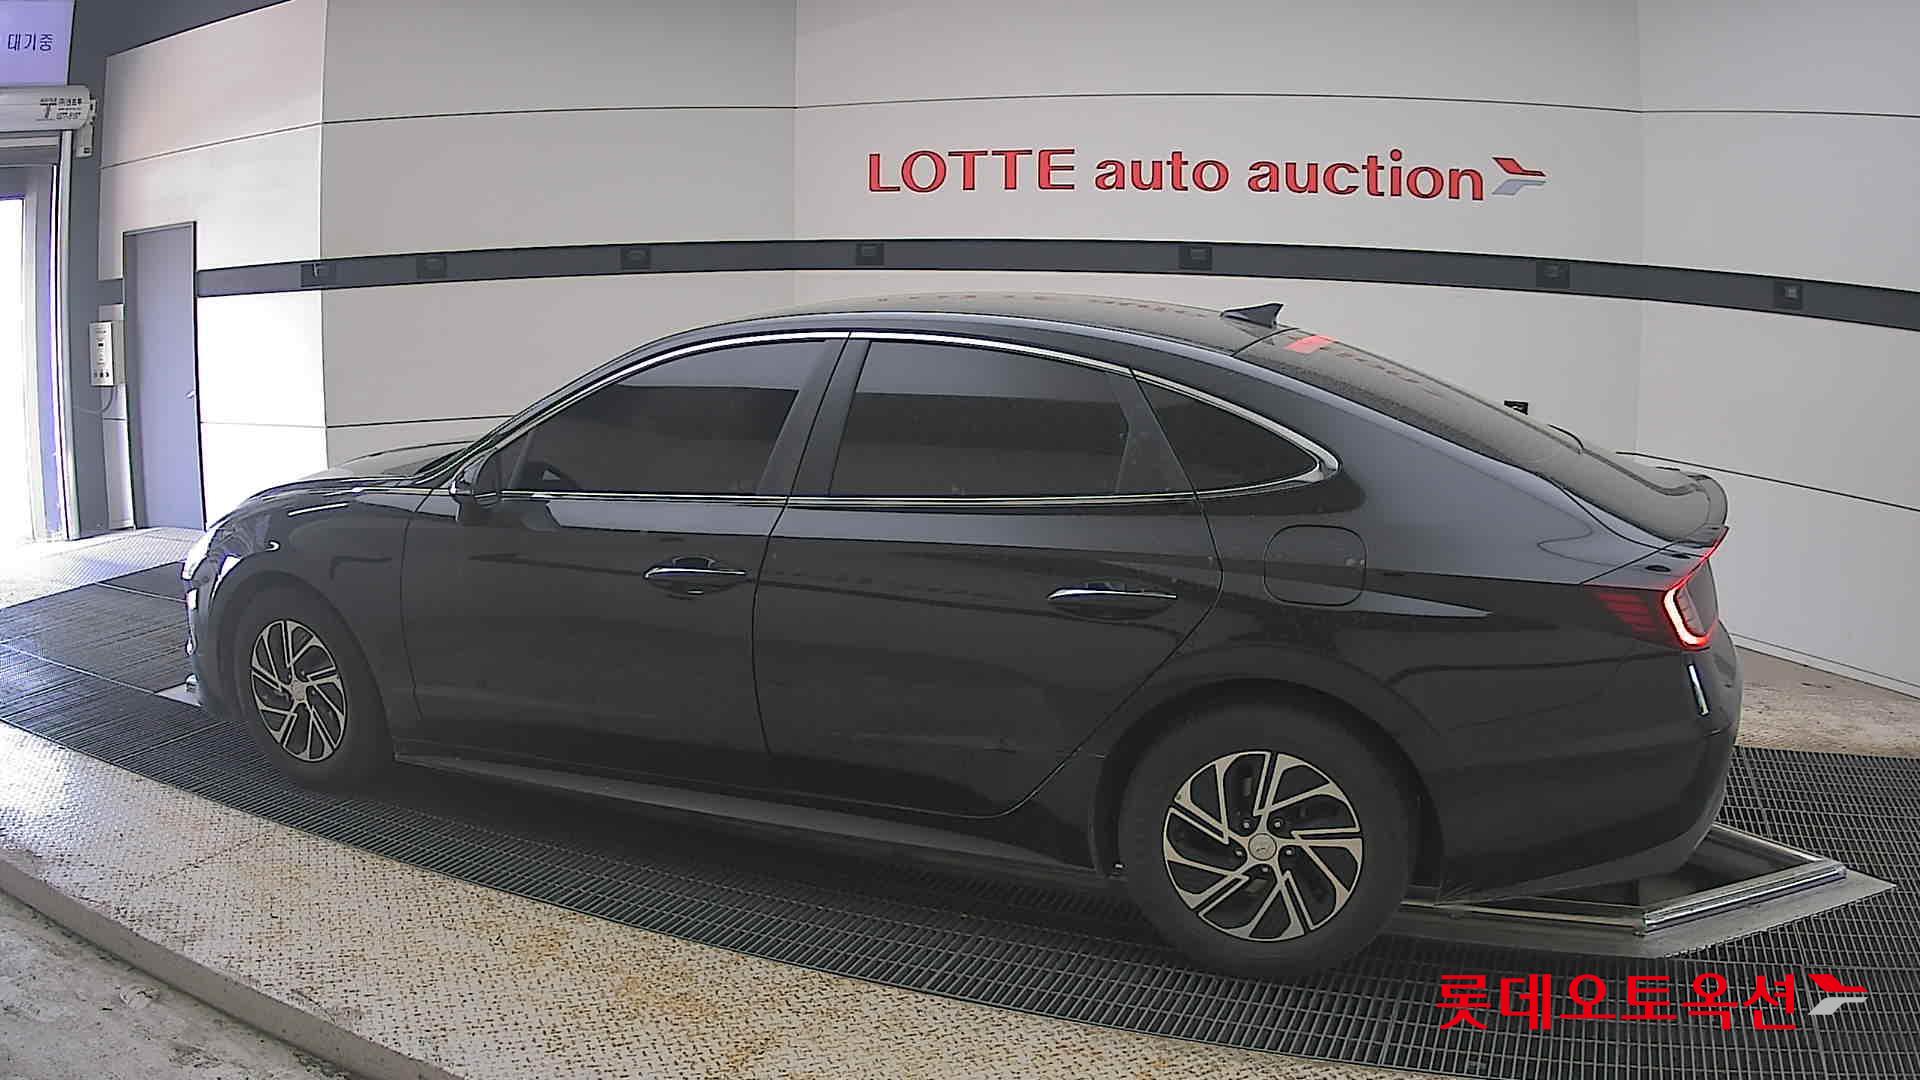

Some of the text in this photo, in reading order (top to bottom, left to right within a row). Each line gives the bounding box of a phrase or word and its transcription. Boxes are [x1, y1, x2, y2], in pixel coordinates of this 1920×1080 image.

[7, 32, 54, 52] 대기중
[867, 148, 1485, 201] LOTTE auto auction
